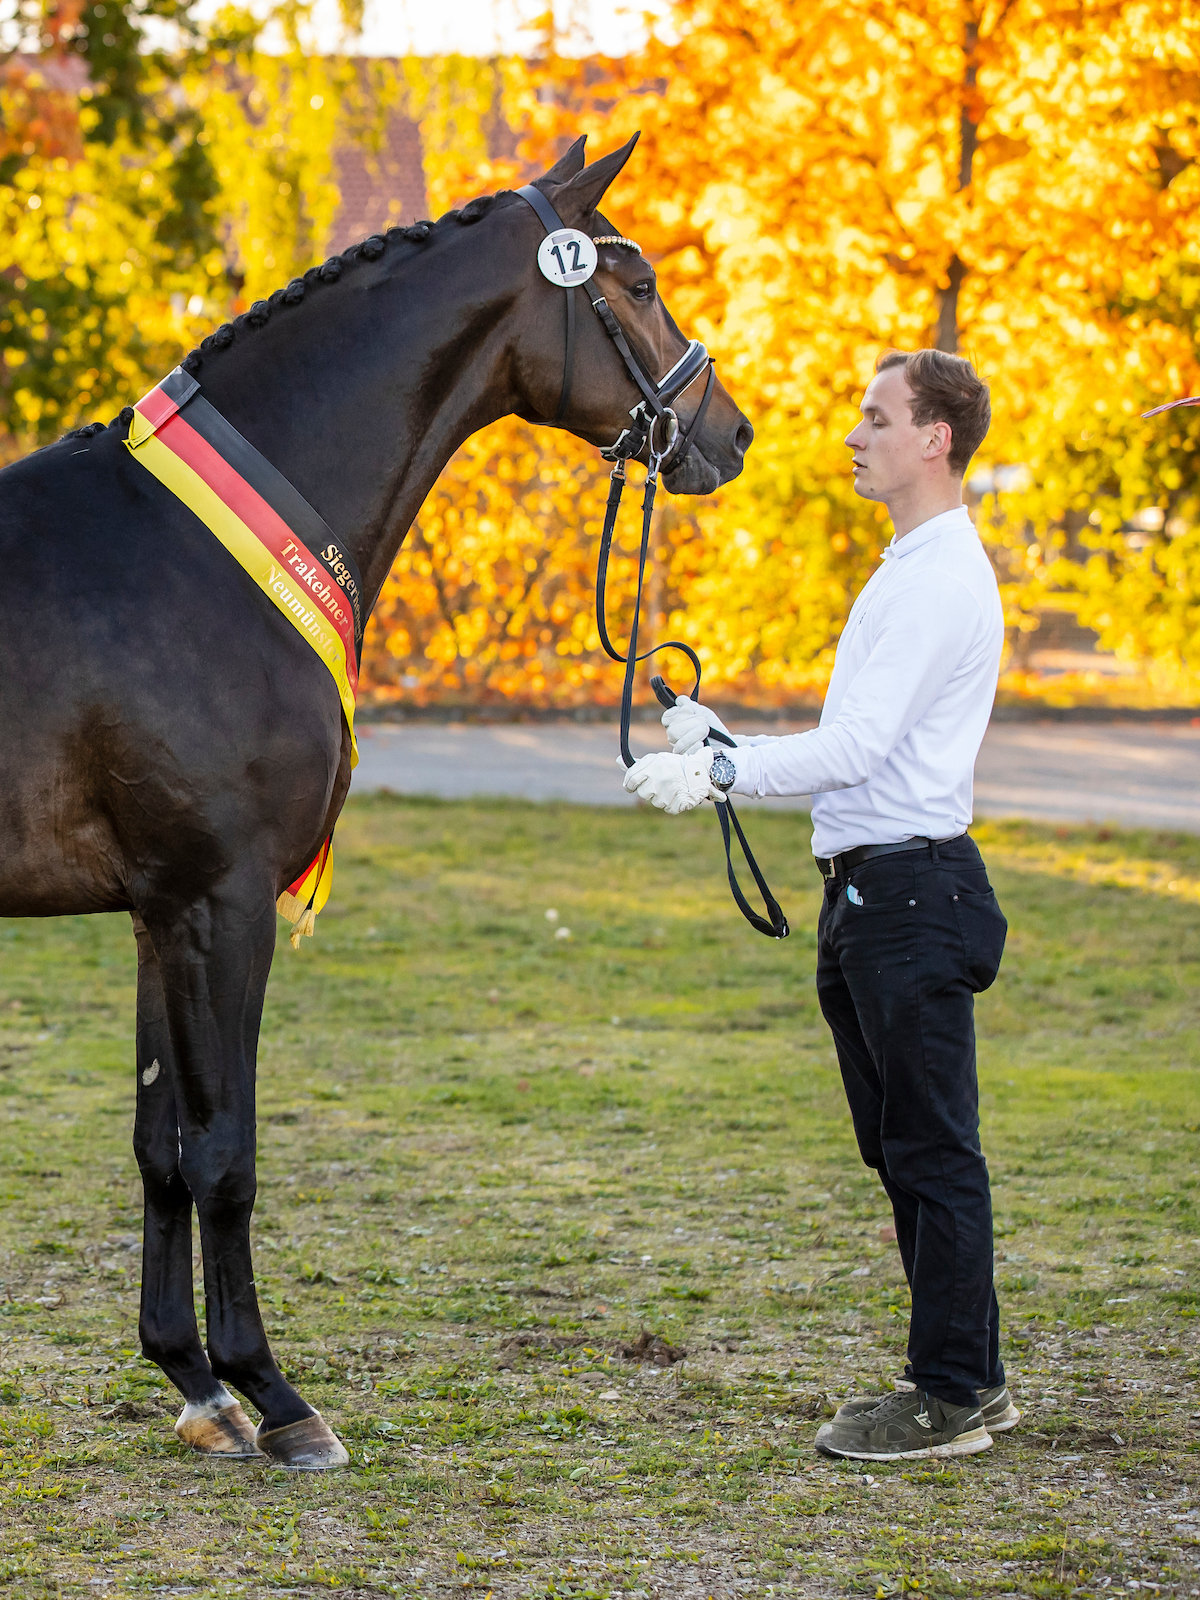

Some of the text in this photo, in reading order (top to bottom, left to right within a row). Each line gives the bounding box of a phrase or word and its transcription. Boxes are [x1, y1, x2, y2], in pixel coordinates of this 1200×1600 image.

[550, 241, 587, 275] 12
[262, 564, 341, 663] Neumünster
[280, 538, 348, 626] Trakehner
